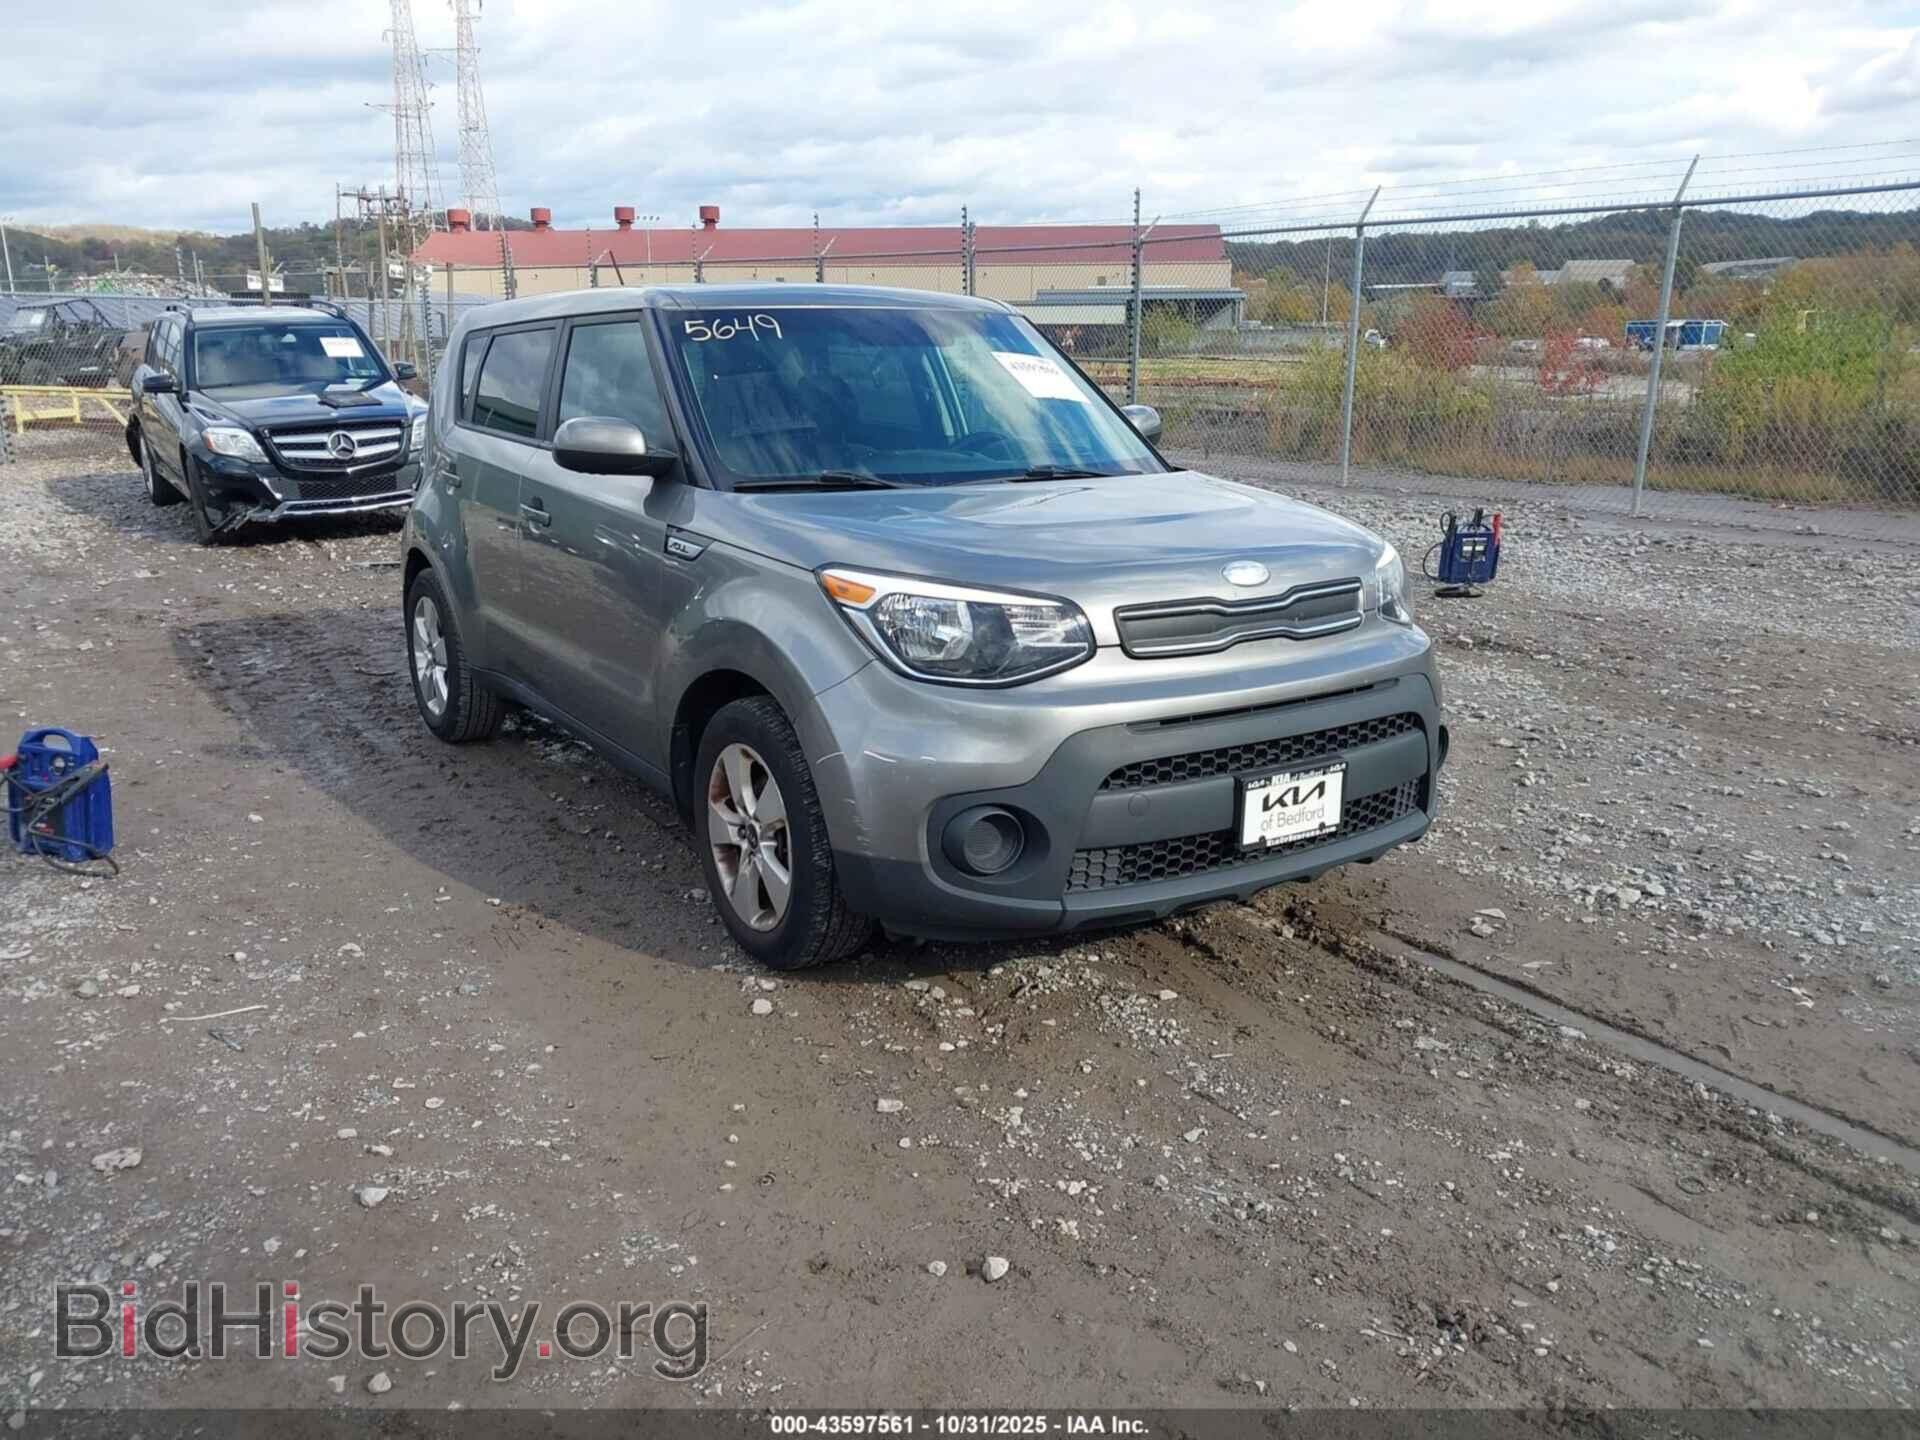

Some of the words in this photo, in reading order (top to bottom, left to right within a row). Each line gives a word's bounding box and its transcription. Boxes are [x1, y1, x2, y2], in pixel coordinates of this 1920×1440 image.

[684, 314, 783, 341] 5649
[1262, 780, 1326, 813] KIA
[1260, 815, 1274, 832] of
[1277, 804, 1325, 828] Bedford
